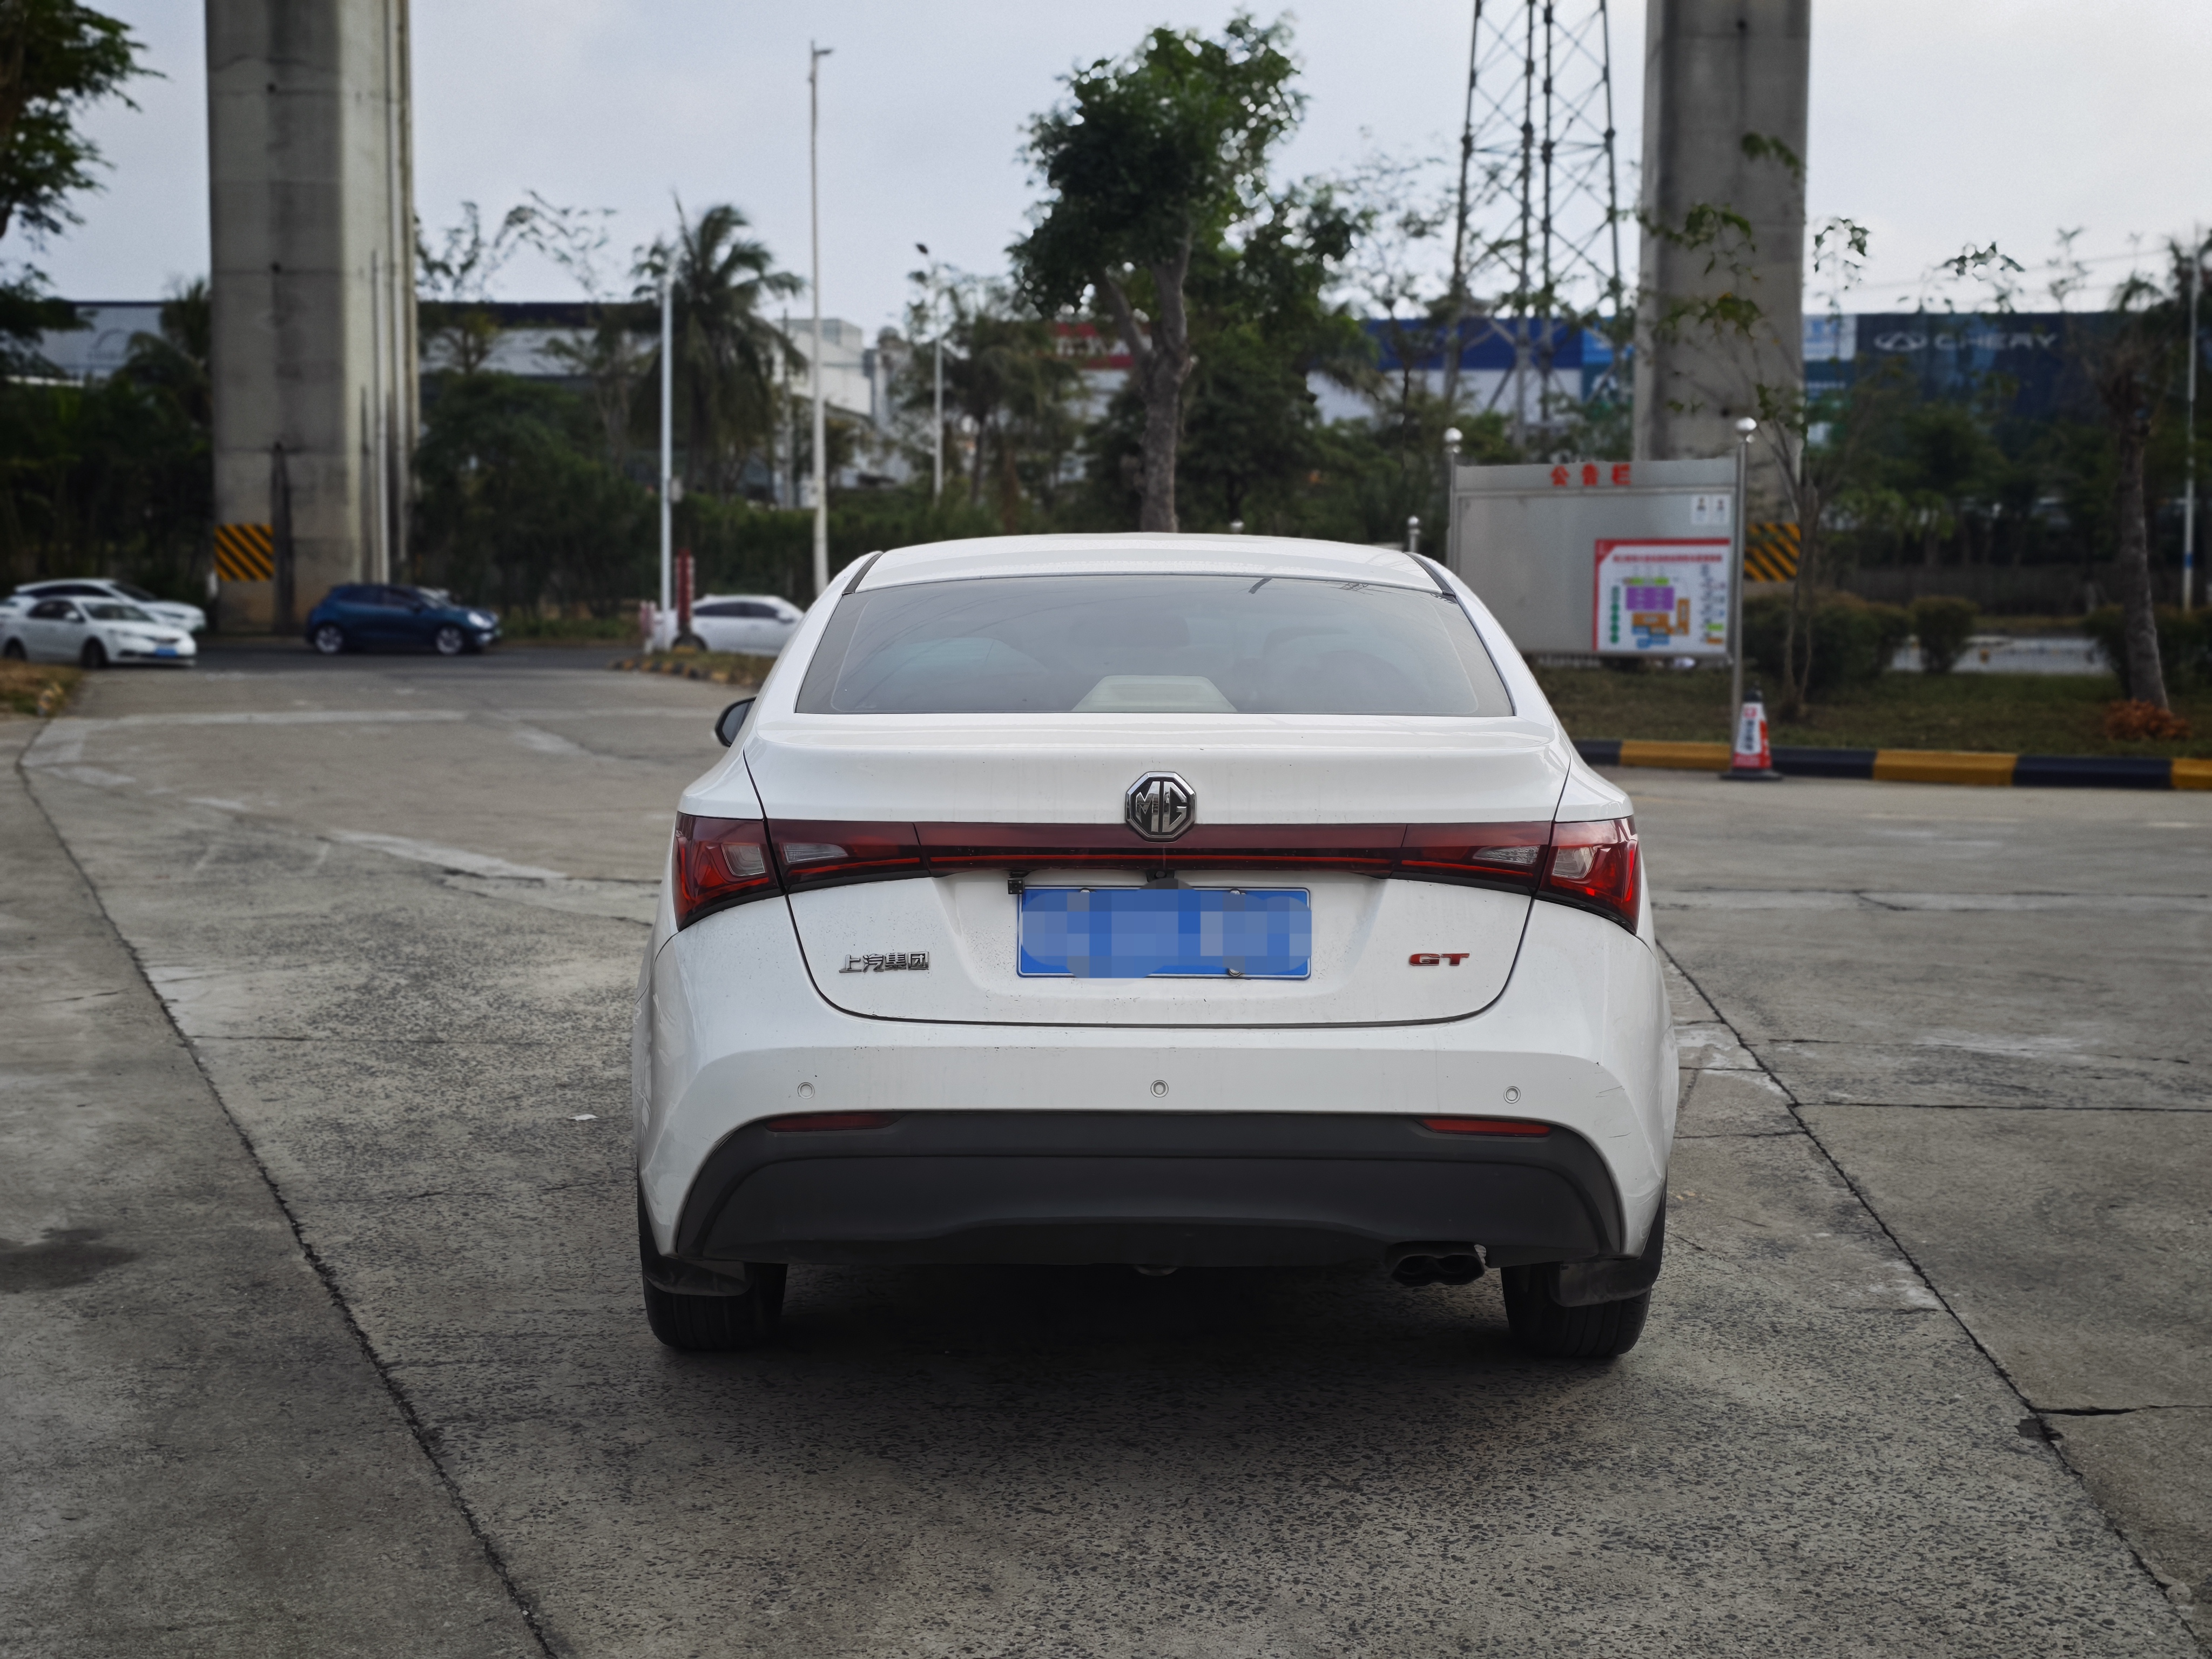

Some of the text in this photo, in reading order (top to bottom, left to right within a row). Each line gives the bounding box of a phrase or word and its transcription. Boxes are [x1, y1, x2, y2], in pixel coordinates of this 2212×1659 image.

[1550, 463, 1632, 485] 公告栏
[1136, 781, 1187, 833] MG
[839, 952, 929, 973] 上汽集团
[1409, 953, 1469, 966] GT
